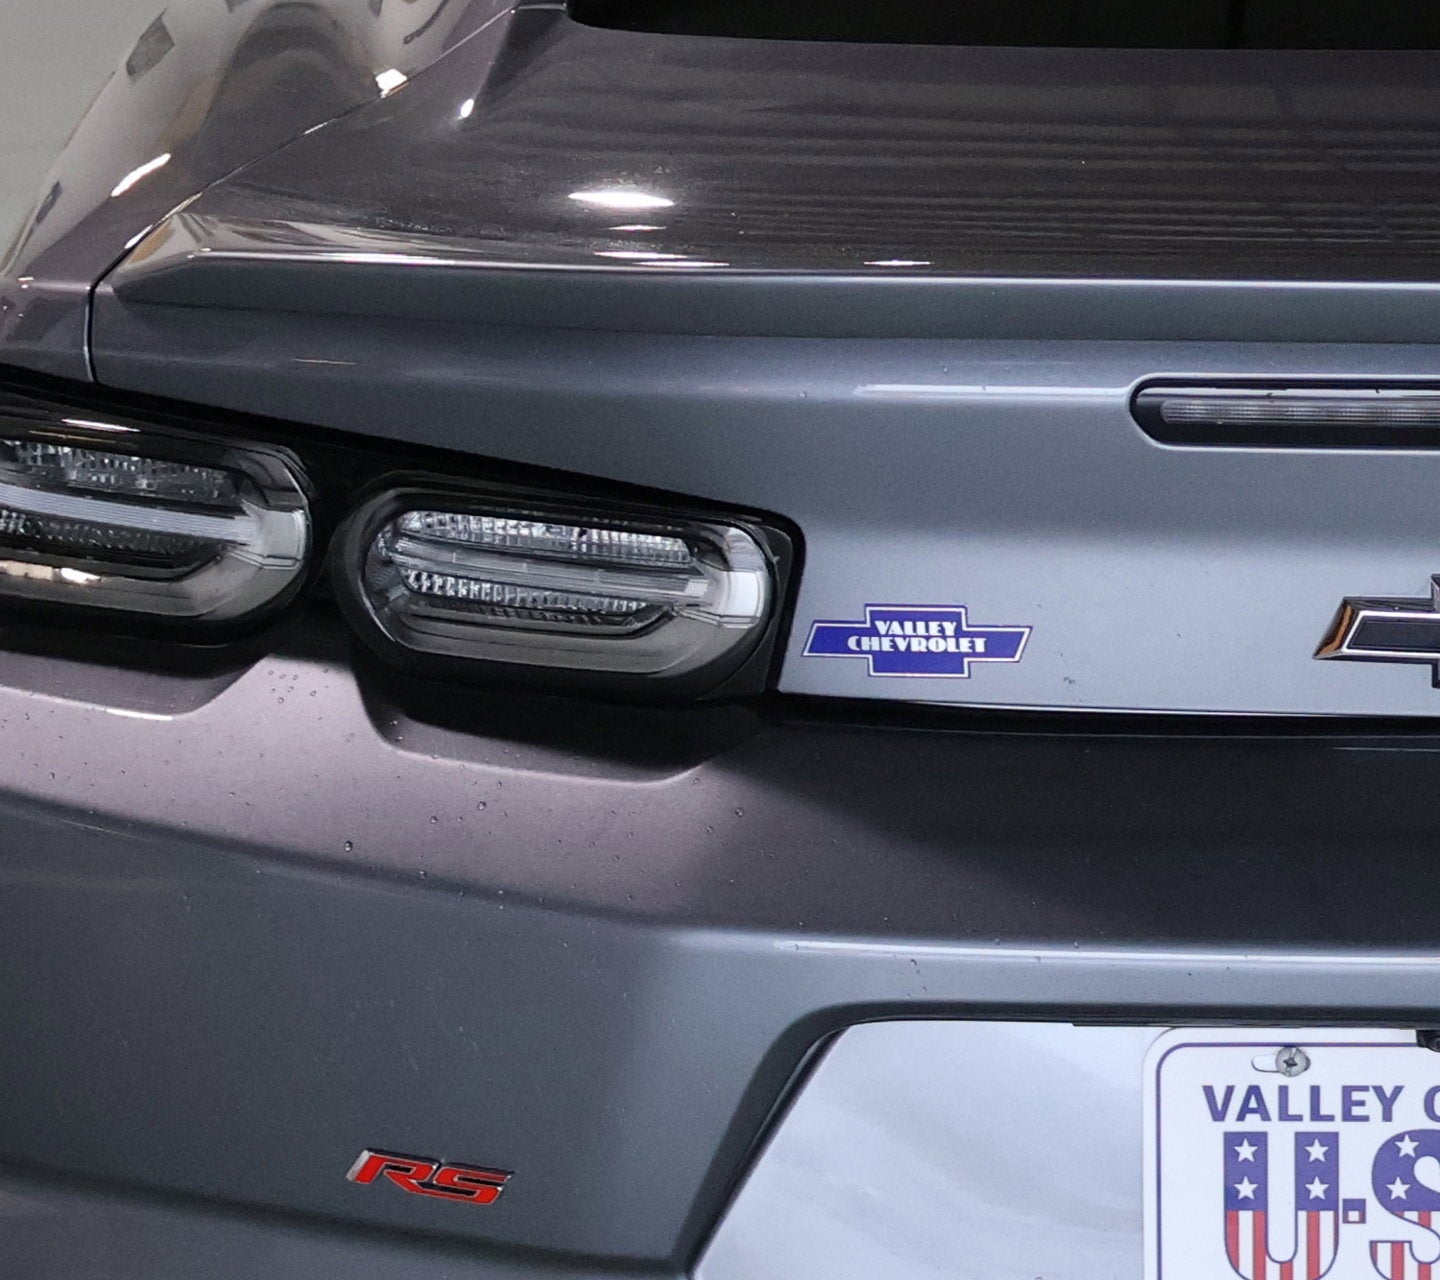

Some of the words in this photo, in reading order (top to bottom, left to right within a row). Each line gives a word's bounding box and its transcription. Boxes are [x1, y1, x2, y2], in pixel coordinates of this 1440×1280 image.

[874, 620, 958, 637] VALLEY
[847, 635, 987, 653] CHEVROLET
[1202, 1083, 1405, 1124] VALLEY
[346, 1147, 516, 1206] RS
